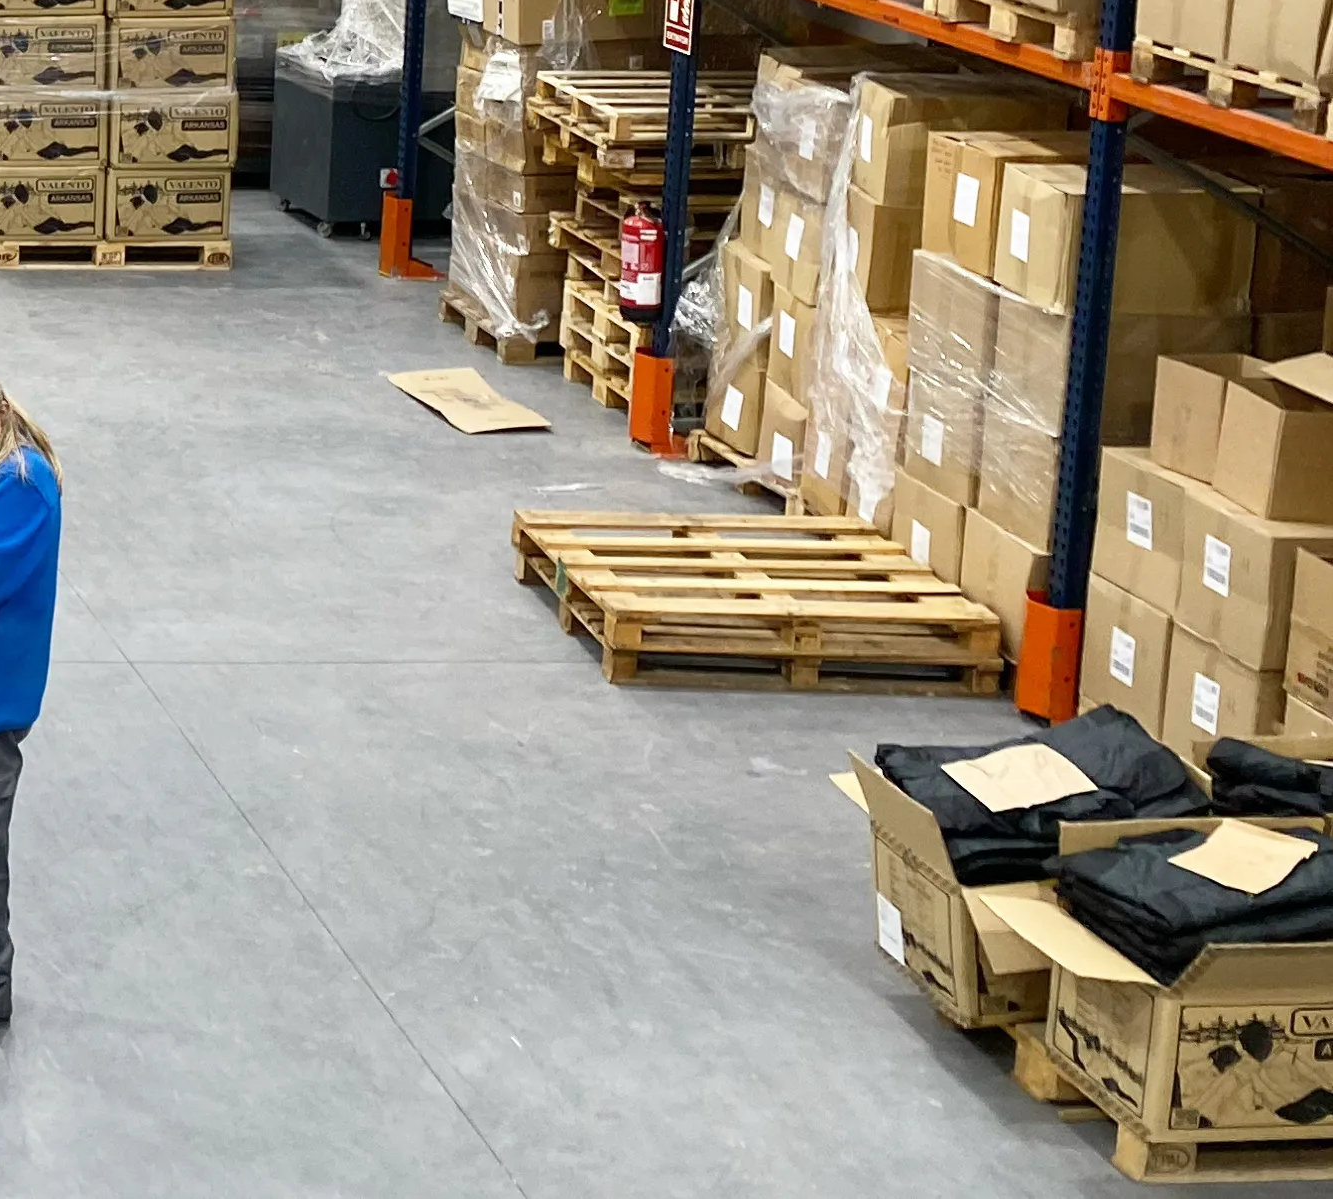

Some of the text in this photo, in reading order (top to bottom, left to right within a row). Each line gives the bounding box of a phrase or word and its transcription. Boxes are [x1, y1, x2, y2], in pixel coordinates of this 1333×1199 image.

[172, 107, 225, 117] VALENTO
[40, 179, 91, 190] VALENTO
[168, 179, 220, 190] VALENTO
